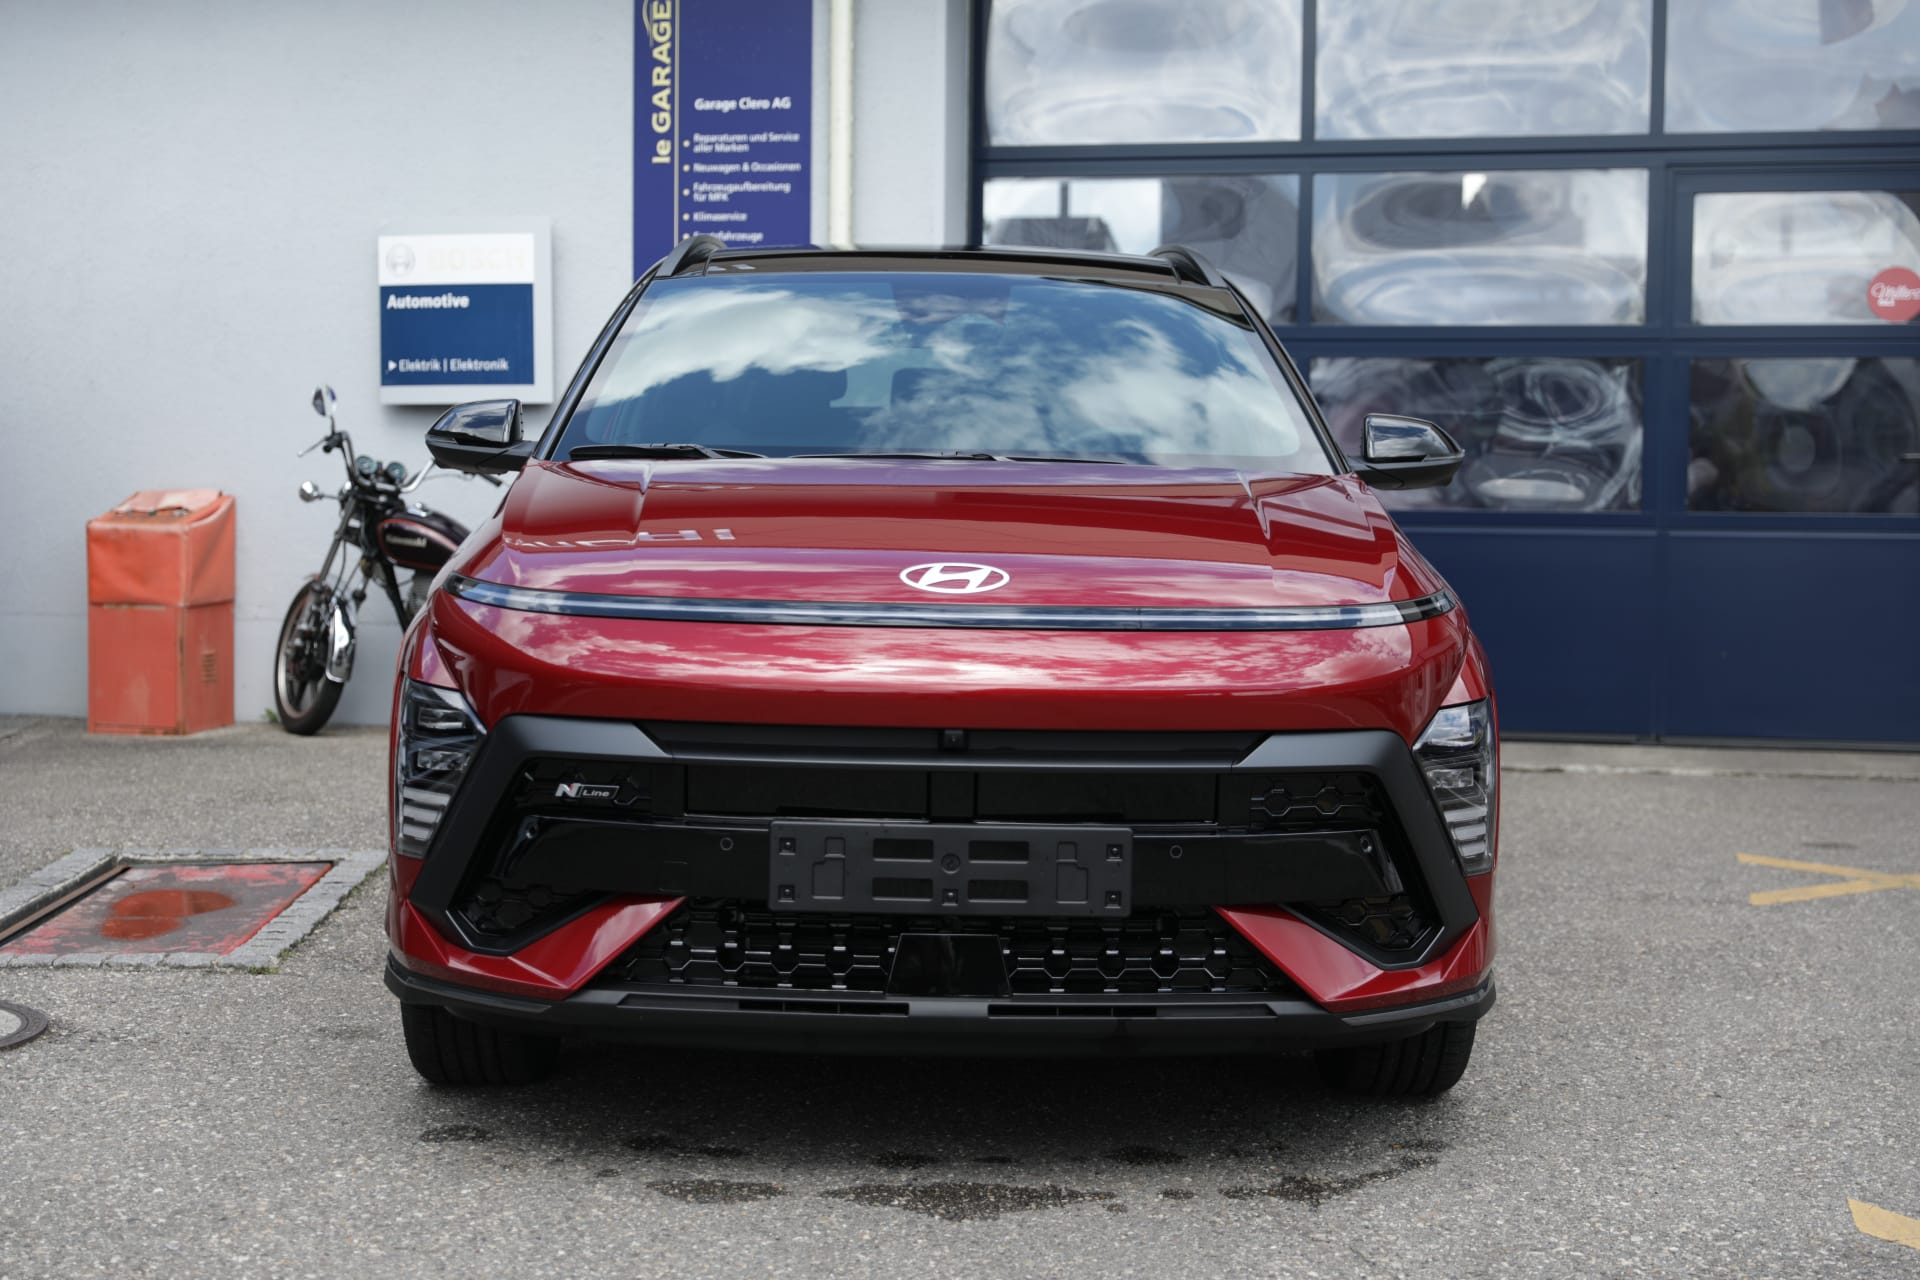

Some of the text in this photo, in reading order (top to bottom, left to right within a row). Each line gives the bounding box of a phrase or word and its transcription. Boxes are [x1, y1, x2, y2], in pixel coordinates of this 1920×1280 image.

[651, 0, 672, 164] le GARAGE
[694, 96, 792, 113] Garage Clero AG
[693, 132, 800, 144] Reparaturen und Service
[693, 143, 749, 153] aller Marken
[693, 162, 801, 174] Neuwagen & Occasionen
[693, 181, 791, 194] Fahrzeugaufbereitung
[693, 191, 707, 202] für
[693, 211, 748, 222] Klimaservice
[387, 293, 470, 310] Automotive
[398, 357, 509, 372] Elektrik Elektronik
[554, 782, 610, 798] N Line
